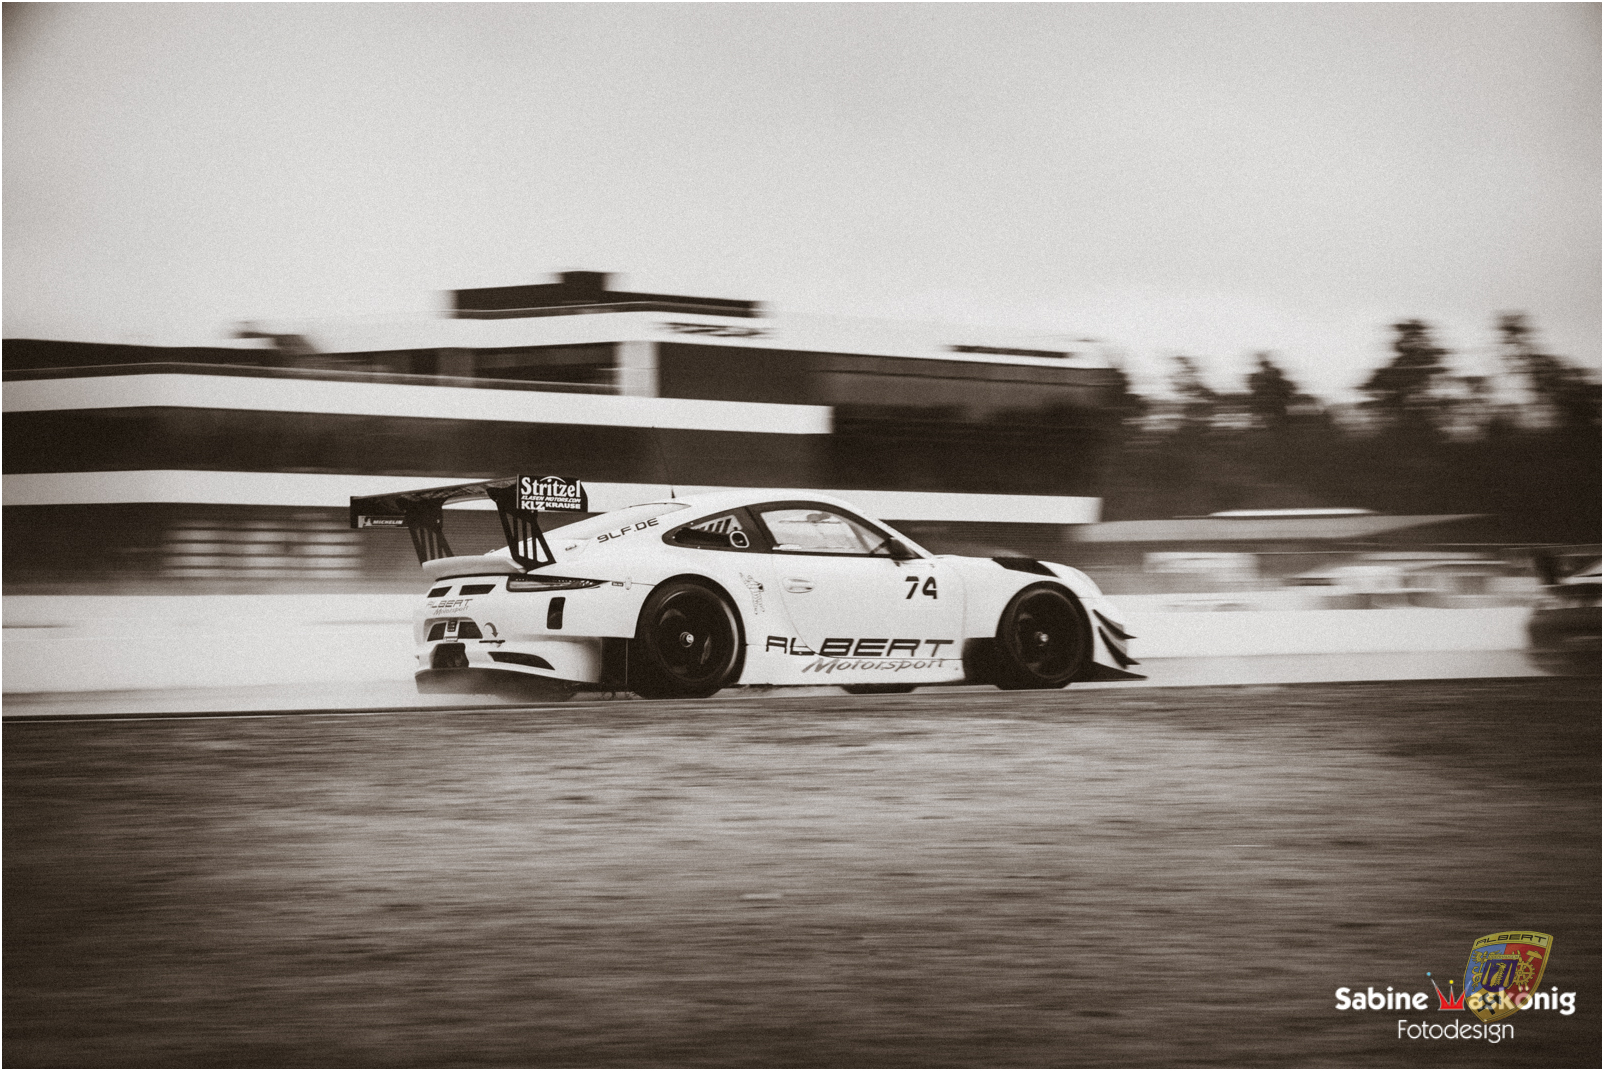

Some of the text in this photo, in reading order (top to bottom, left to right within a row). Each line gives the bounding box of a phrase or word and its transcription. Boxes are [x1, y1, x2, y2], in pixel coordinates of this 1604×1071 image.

[520, 476, 581, 498] Stritzel
[521, 500, 581, 511] KLZ KRAUSE
[596, 517, 659, 544] 9LF.DE
[905, 575, 938, 600] 74
[426, 598, 474, 609] ALBERT
[765, 635, 955, 658] ALBERT
[801, 657, 946, 675] Motorsport
